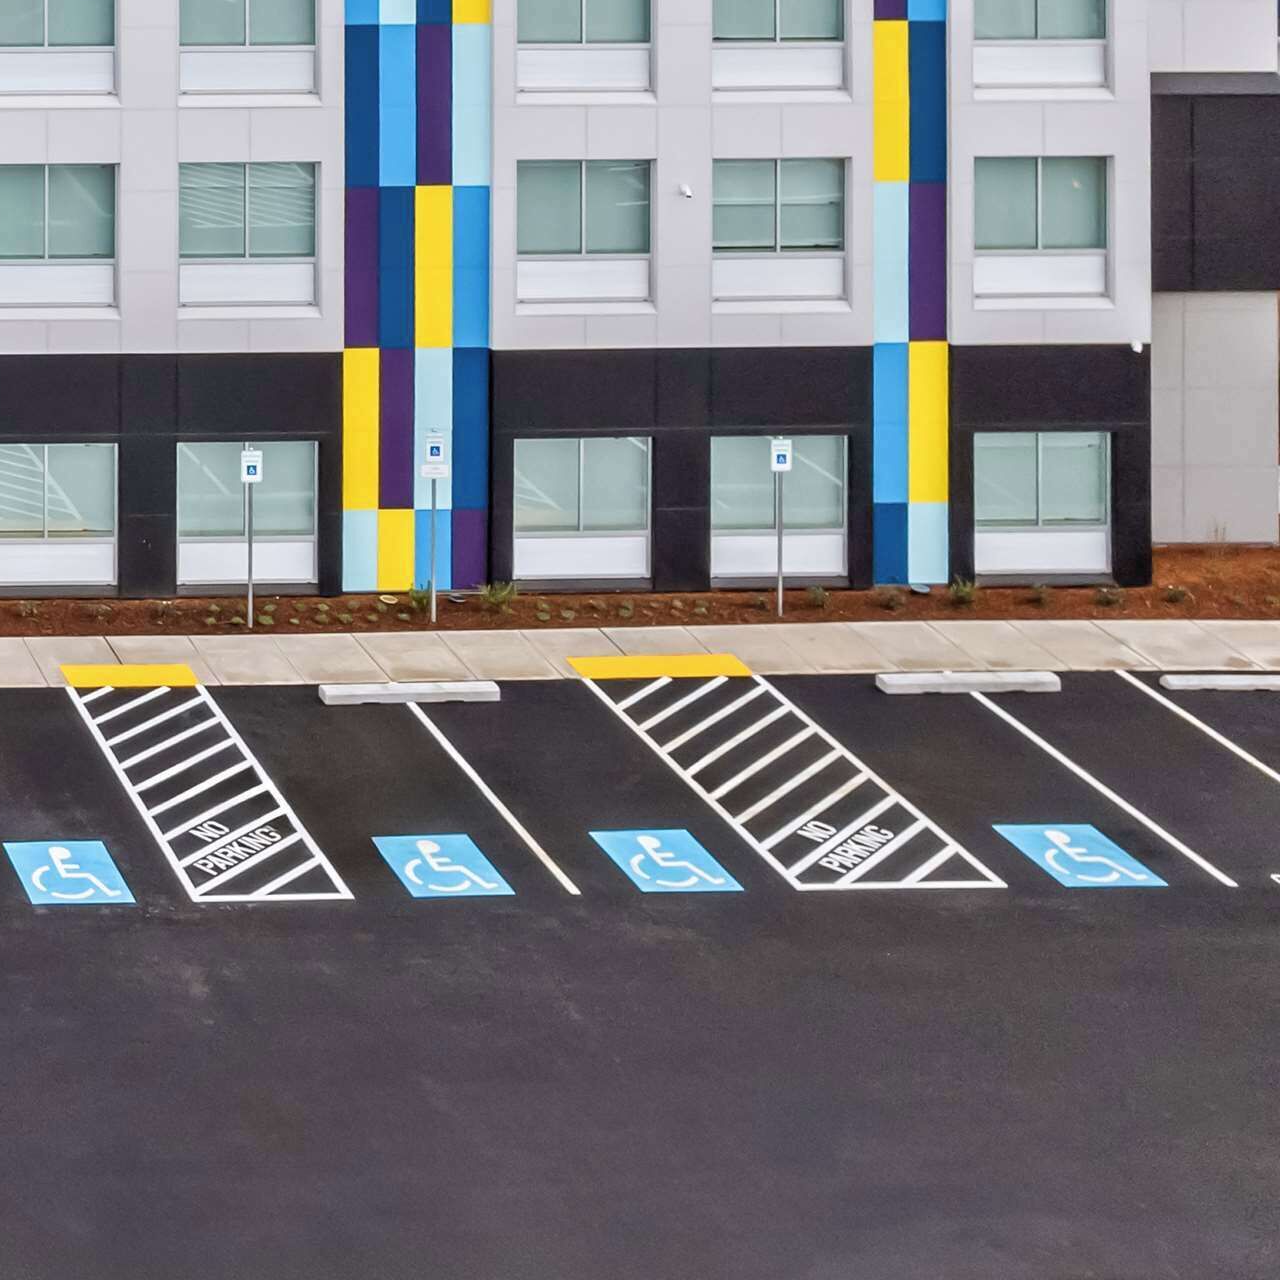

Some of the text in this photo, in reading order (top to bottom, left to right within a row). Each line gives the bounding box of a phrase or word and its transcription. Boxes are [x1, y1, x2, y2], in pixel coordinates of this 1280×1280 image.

[189, 820, 231, 843] NO
[796, 820, 838, 843] NO
[817, 824, 895, 874] PARKING
[192, 826, 282, 875] PARKING
